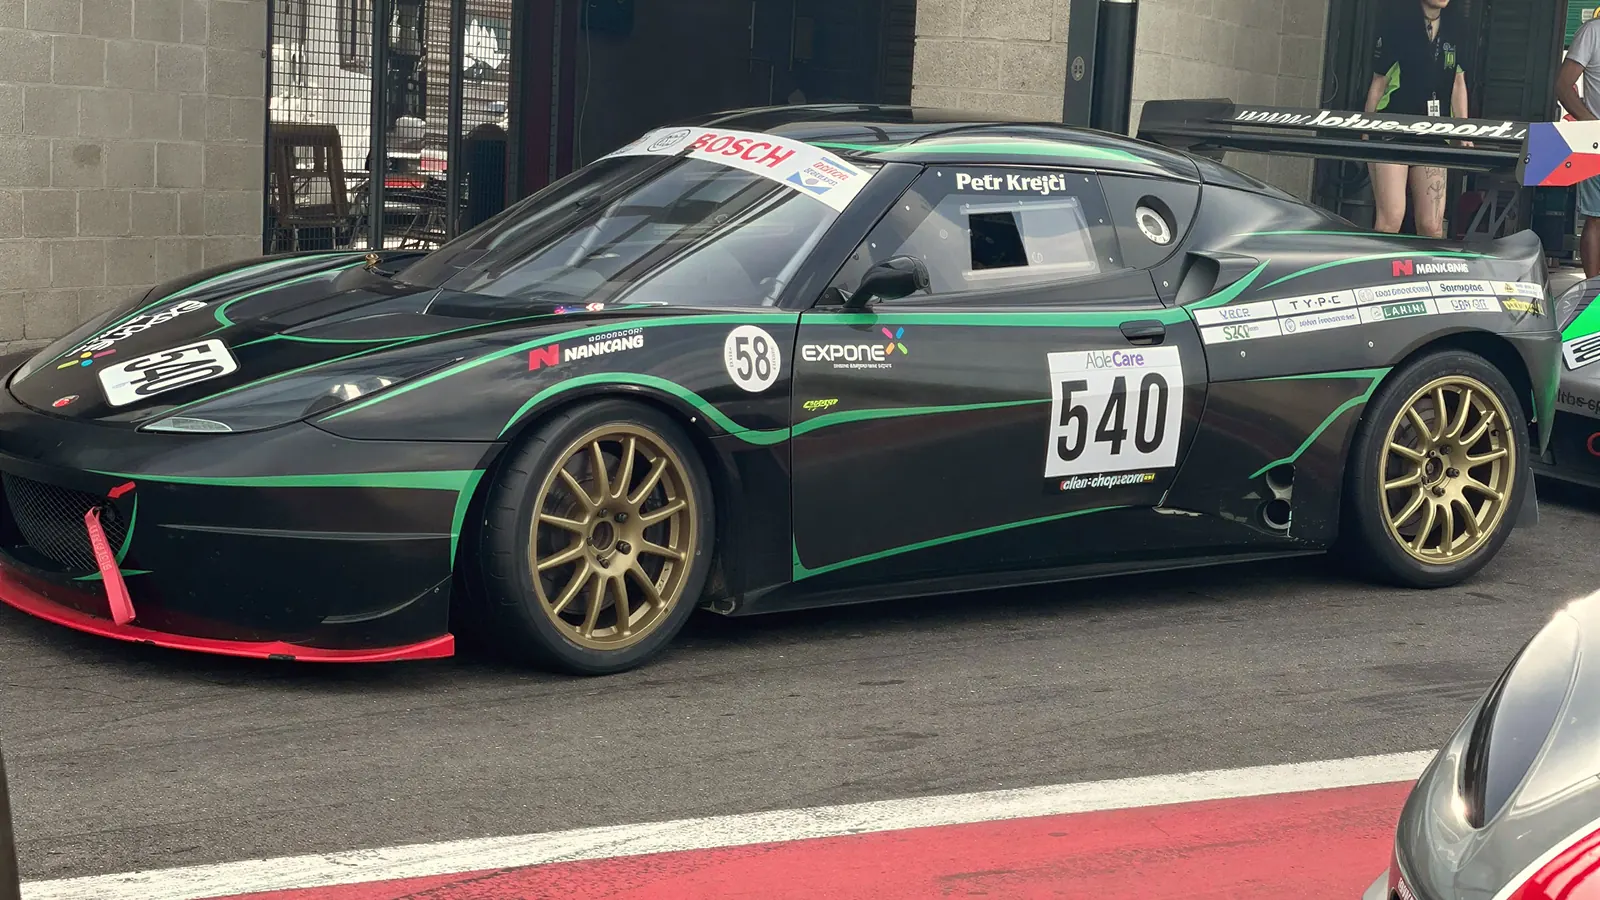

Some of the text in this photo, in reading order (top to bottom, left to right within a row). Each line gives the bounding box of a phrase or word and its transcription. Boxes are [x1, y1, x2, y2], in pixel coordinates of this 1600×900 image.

[691, 133, 796, 168] BOSCH
[955, 173, 1003, 191] Petr
[564, 334, 644, 362] NANKANG
[735, 335, 771, 381] 58
[802, 344, 886, 362] EXPONE
[123, 344, 225, 396] 540
[1057, 372, 1169, 462] 540
